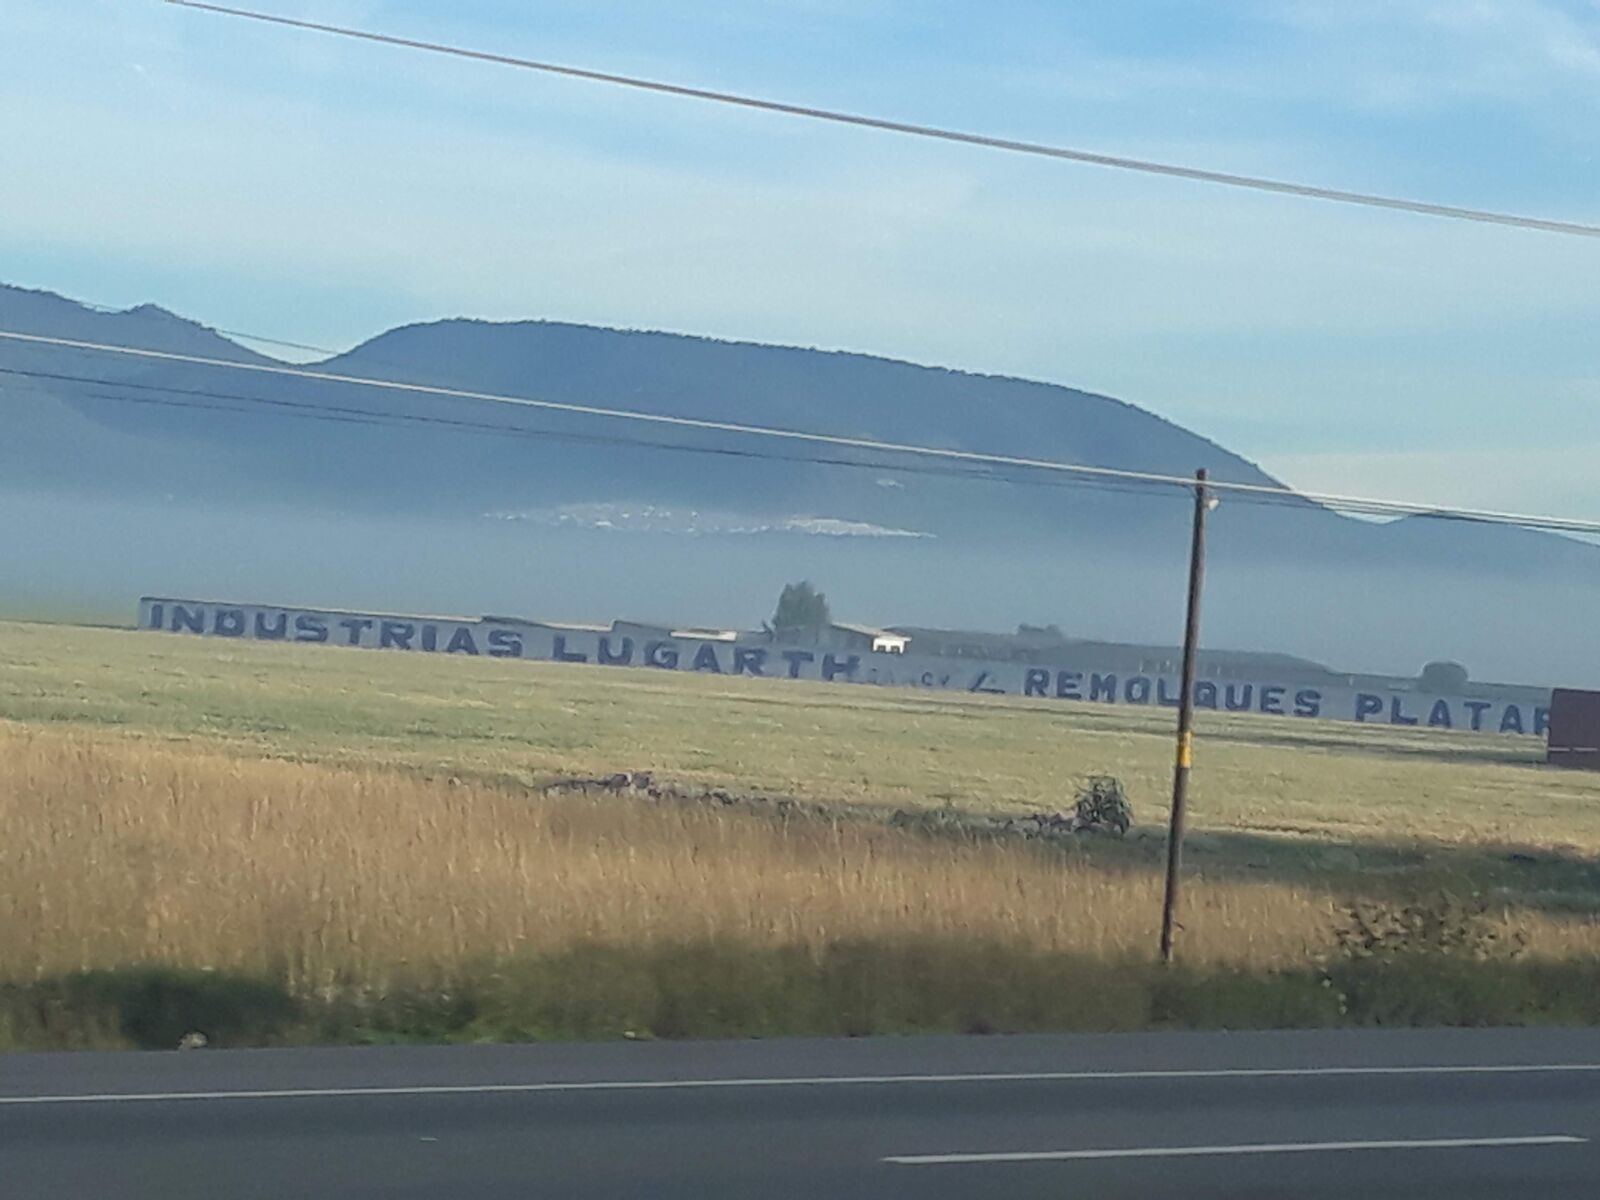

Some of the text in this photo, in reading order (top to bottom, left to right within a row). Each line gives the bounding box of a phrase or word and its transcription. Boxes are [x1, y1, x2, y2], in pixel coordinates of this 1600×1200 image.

[150, 604, 524, 658] INDUSTRIAS
[552, 634, 861, 682] LUGARTH
[1024, 668, 1322, 718] REMOLQUES
